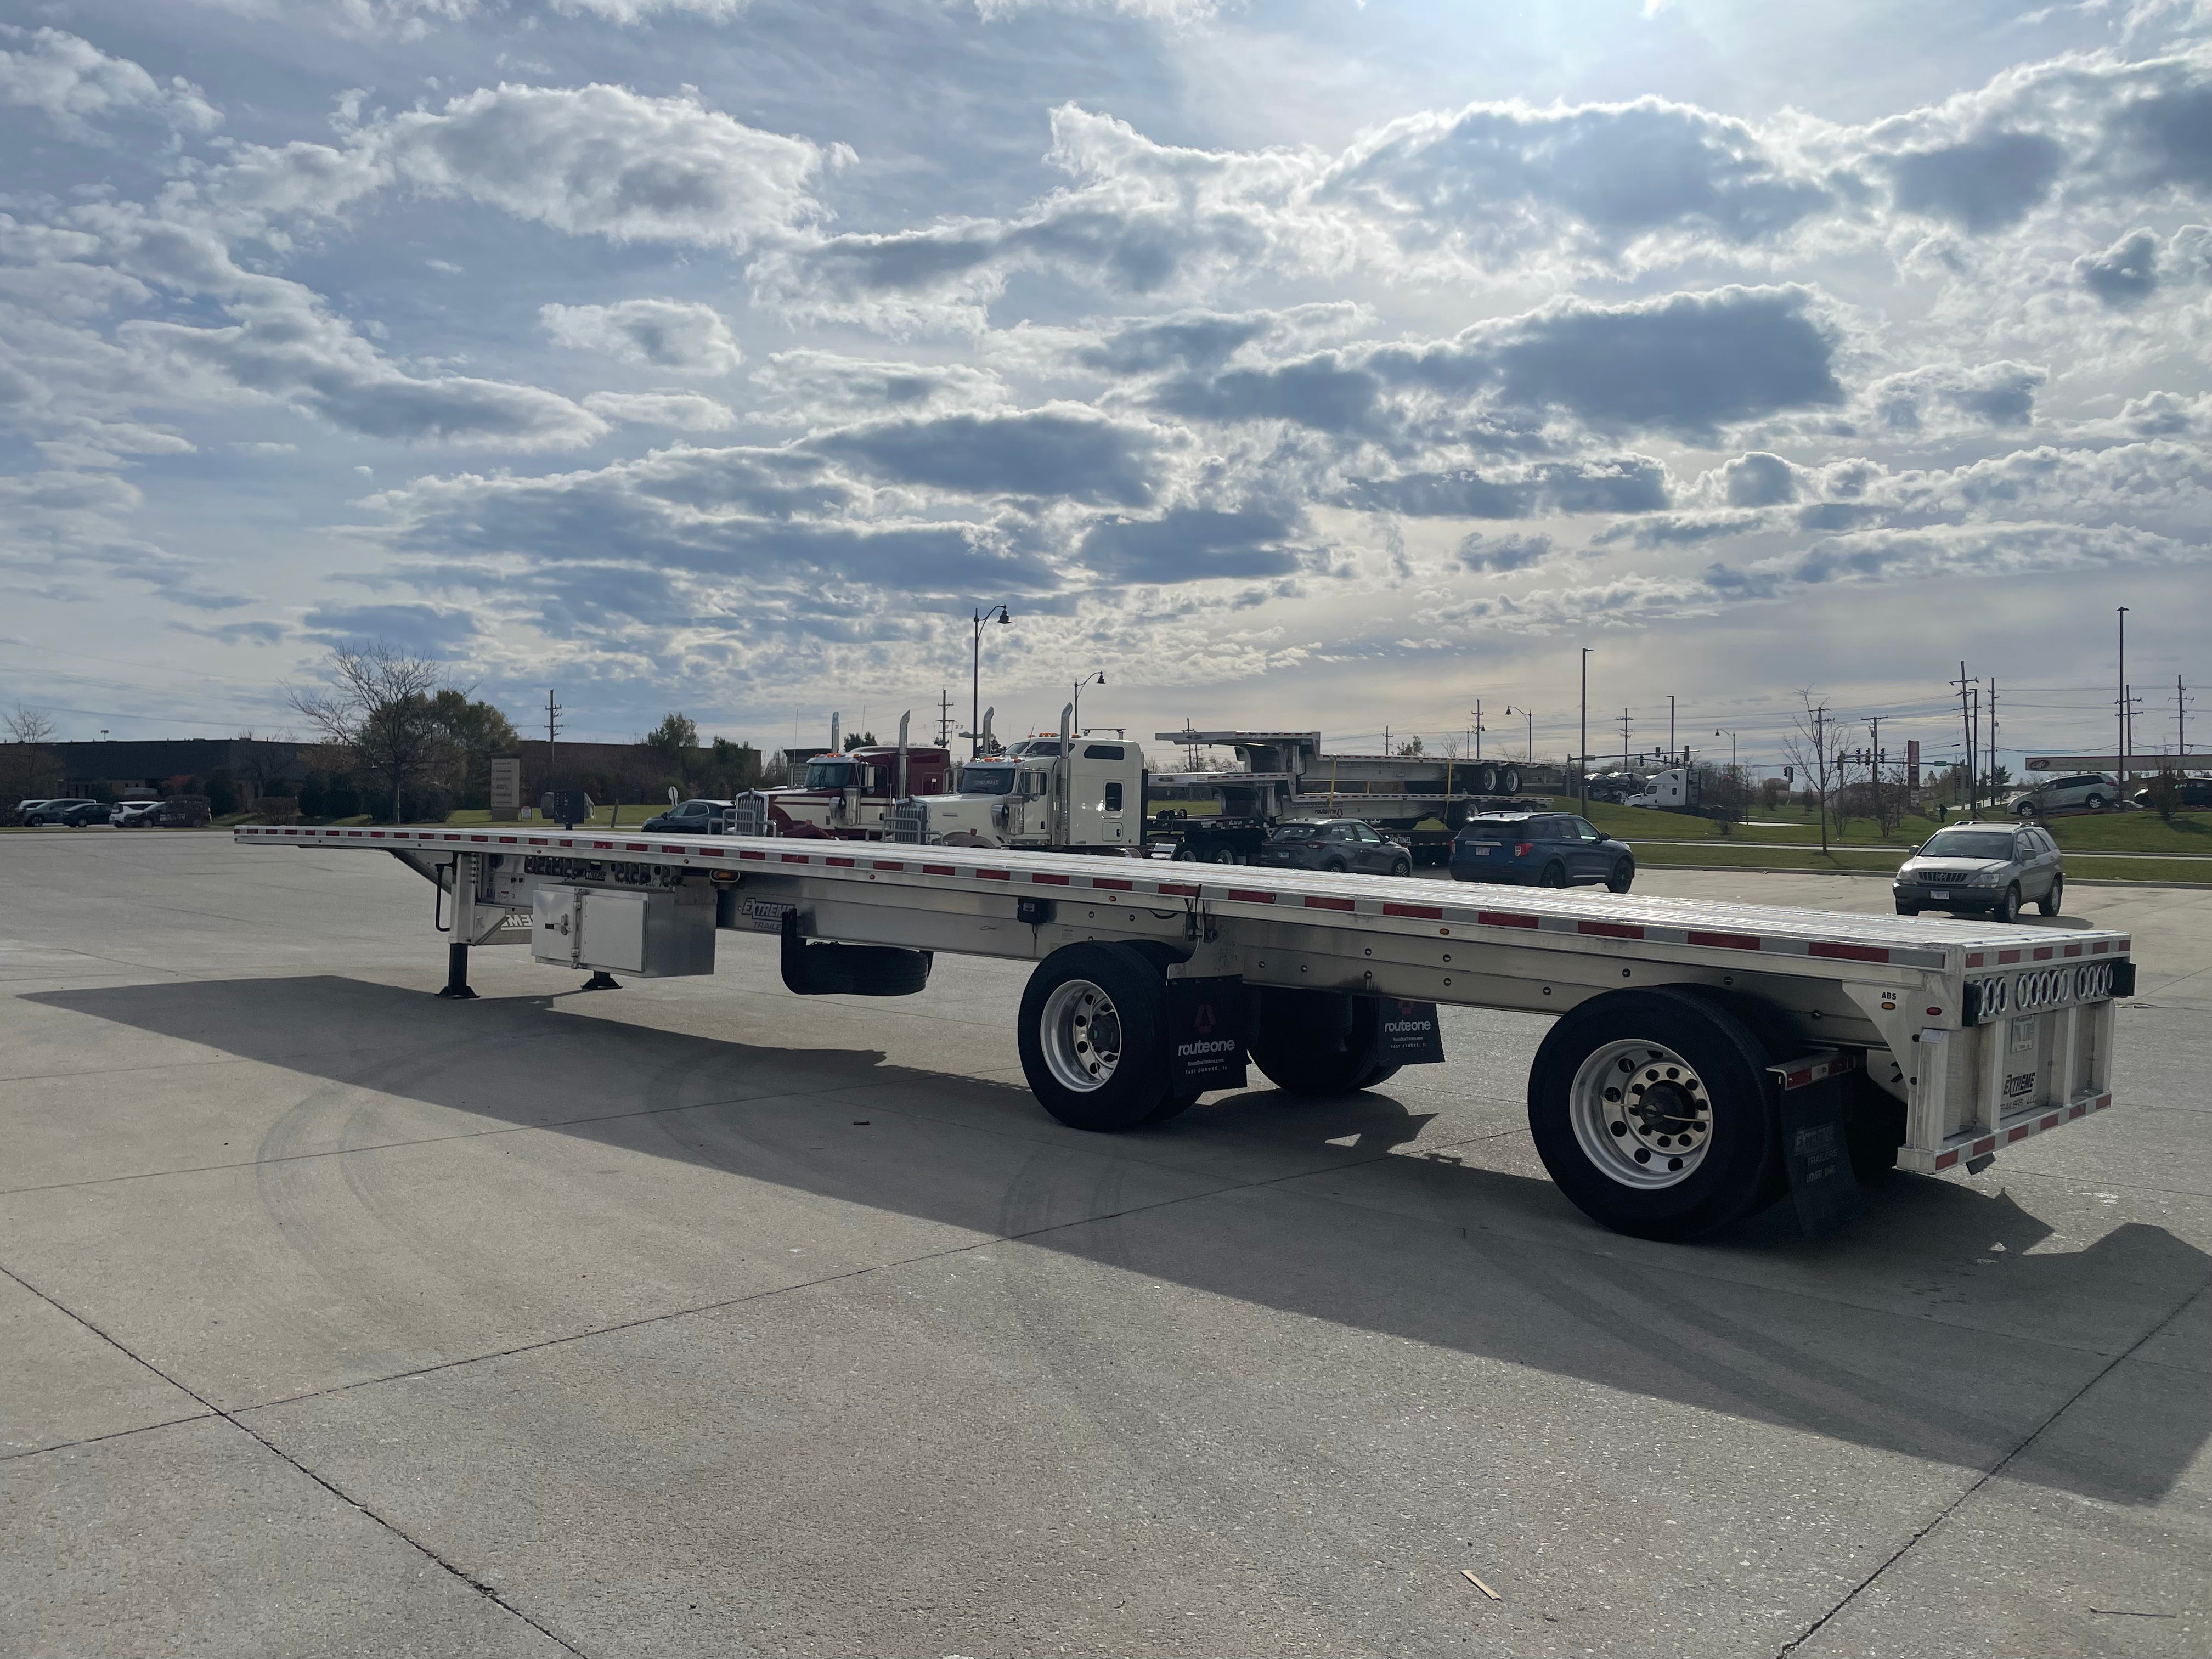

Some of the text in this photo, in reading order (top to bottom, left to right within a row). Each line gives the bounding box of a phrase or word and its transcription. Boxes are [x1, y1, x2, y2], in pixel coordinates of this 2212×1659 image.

[753, 922, 782, 930] TRAILE
[1881, 991, 1897, 1000] ABS
[1385, 1019, 1431, 1032] routeone
[1178, 1040, 1235, 1056] routeone
[2003, 1072, 2036, 1097] EXTREME
[2027, 1095, 2036, 1104] LLC
